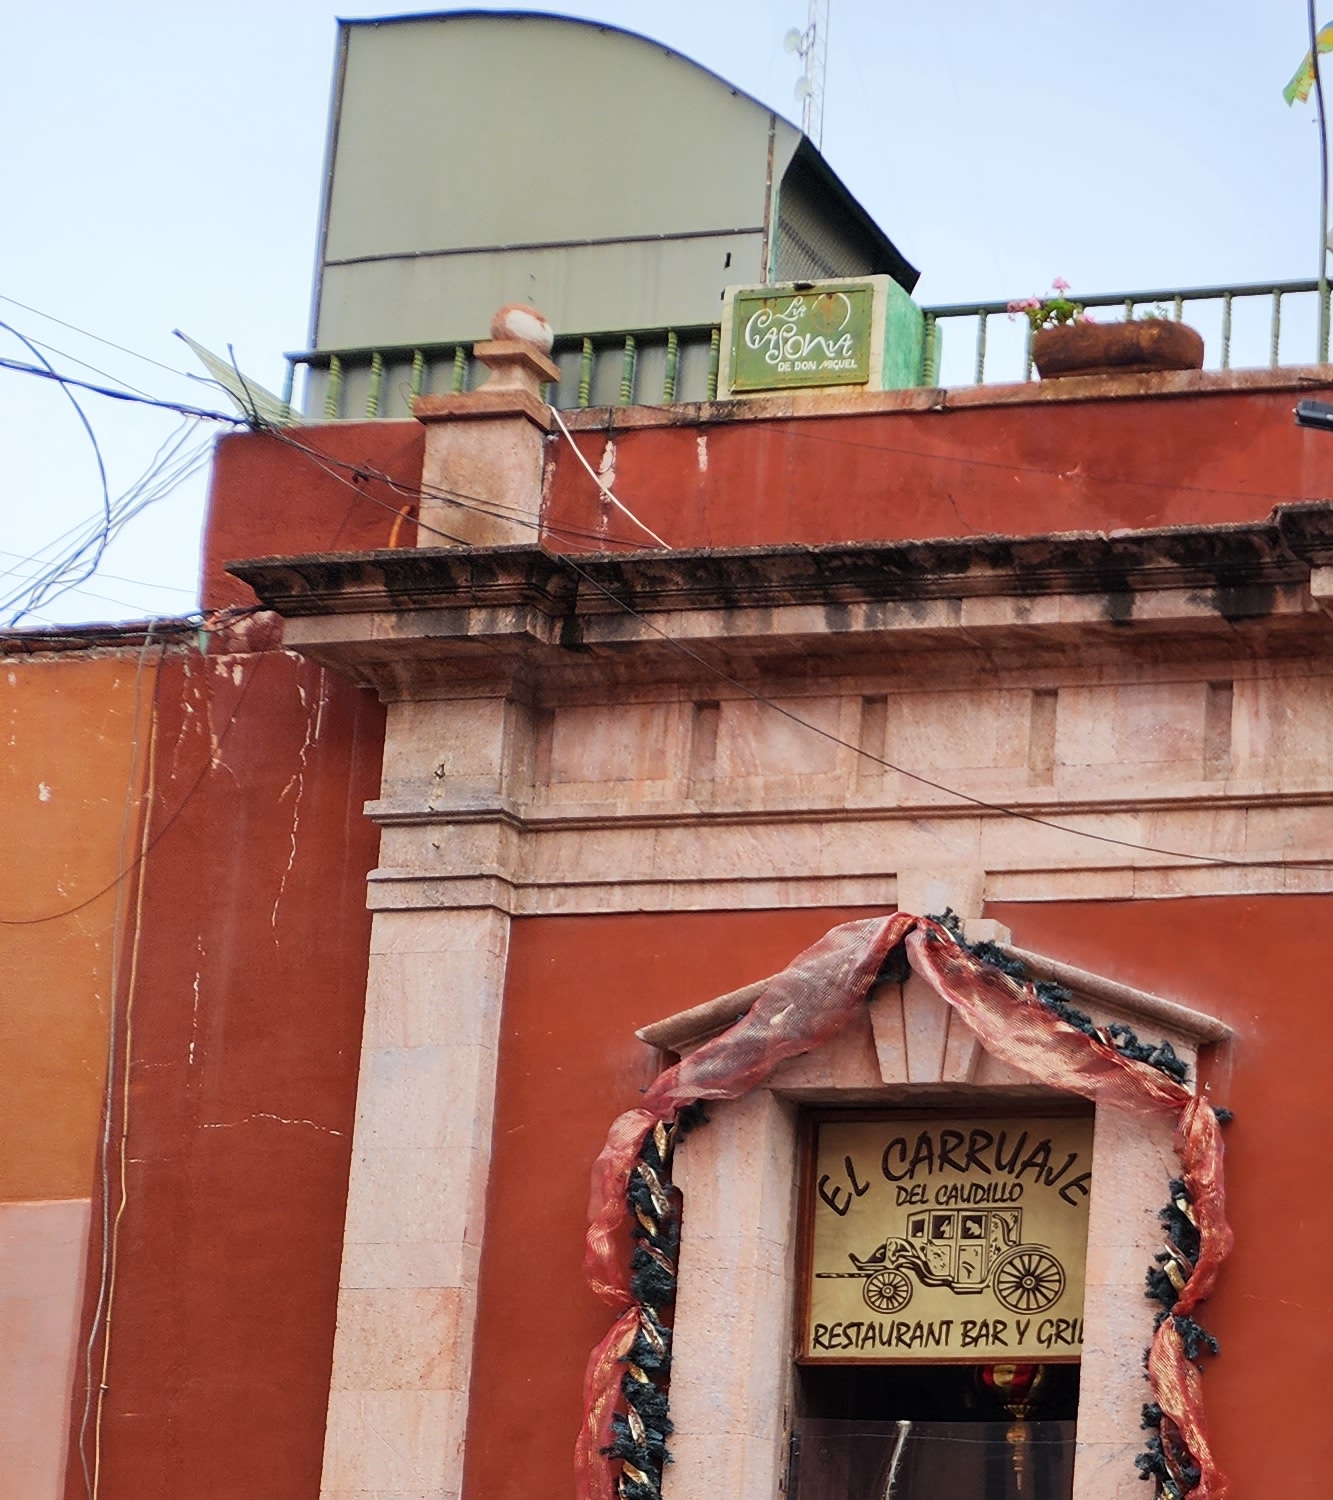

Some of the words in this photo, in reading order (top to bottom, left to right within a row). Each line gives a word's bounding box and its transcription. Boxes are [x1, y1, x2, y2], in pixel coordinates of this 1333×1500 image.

[778, 362, 791, 371] DE
[794, 361, 816, 370] DON
[819, 359, 858, 370] MIGUEL
[818, 1155, 870, 1216] EL
[881, 1129, 1092, 1206] CARRUAJE
[896, 1184, 928, 1206] DEL
[935, 1182, 1024, 1206] CAUDILLO
[812, 1319, 953, 1350] RESTAURANT
[960, 1319, 1008, 1348] BAR
[1016, 1319, 1031, 1347] Y
